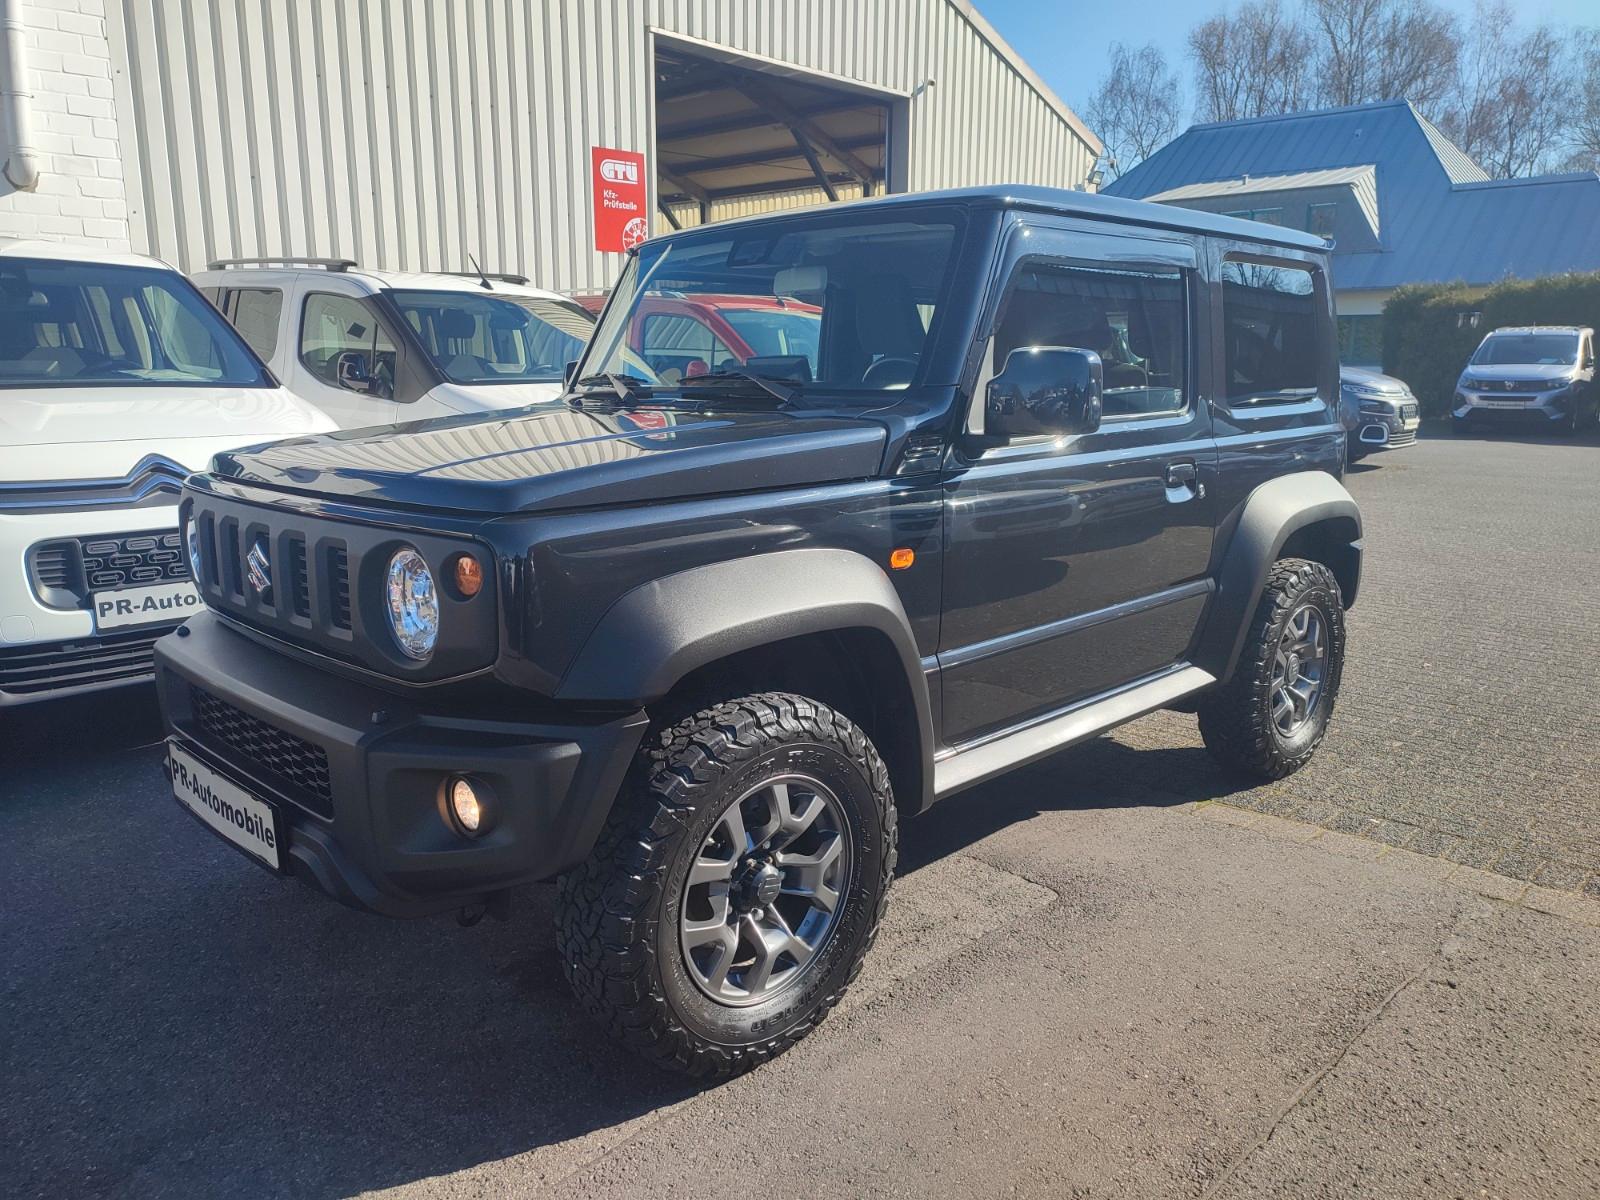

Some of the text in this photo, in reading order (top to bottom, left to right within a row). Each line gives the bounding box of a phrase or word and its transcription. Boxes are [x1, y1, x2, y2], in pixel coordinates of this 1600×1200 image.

[603, 189, 618, 199] Kfz-
[603, 200, 637, 210] Prüfstelle
[99, 591, 203, 618] PR-Auto
[171, 757, 275, 849] PR-Automobile
